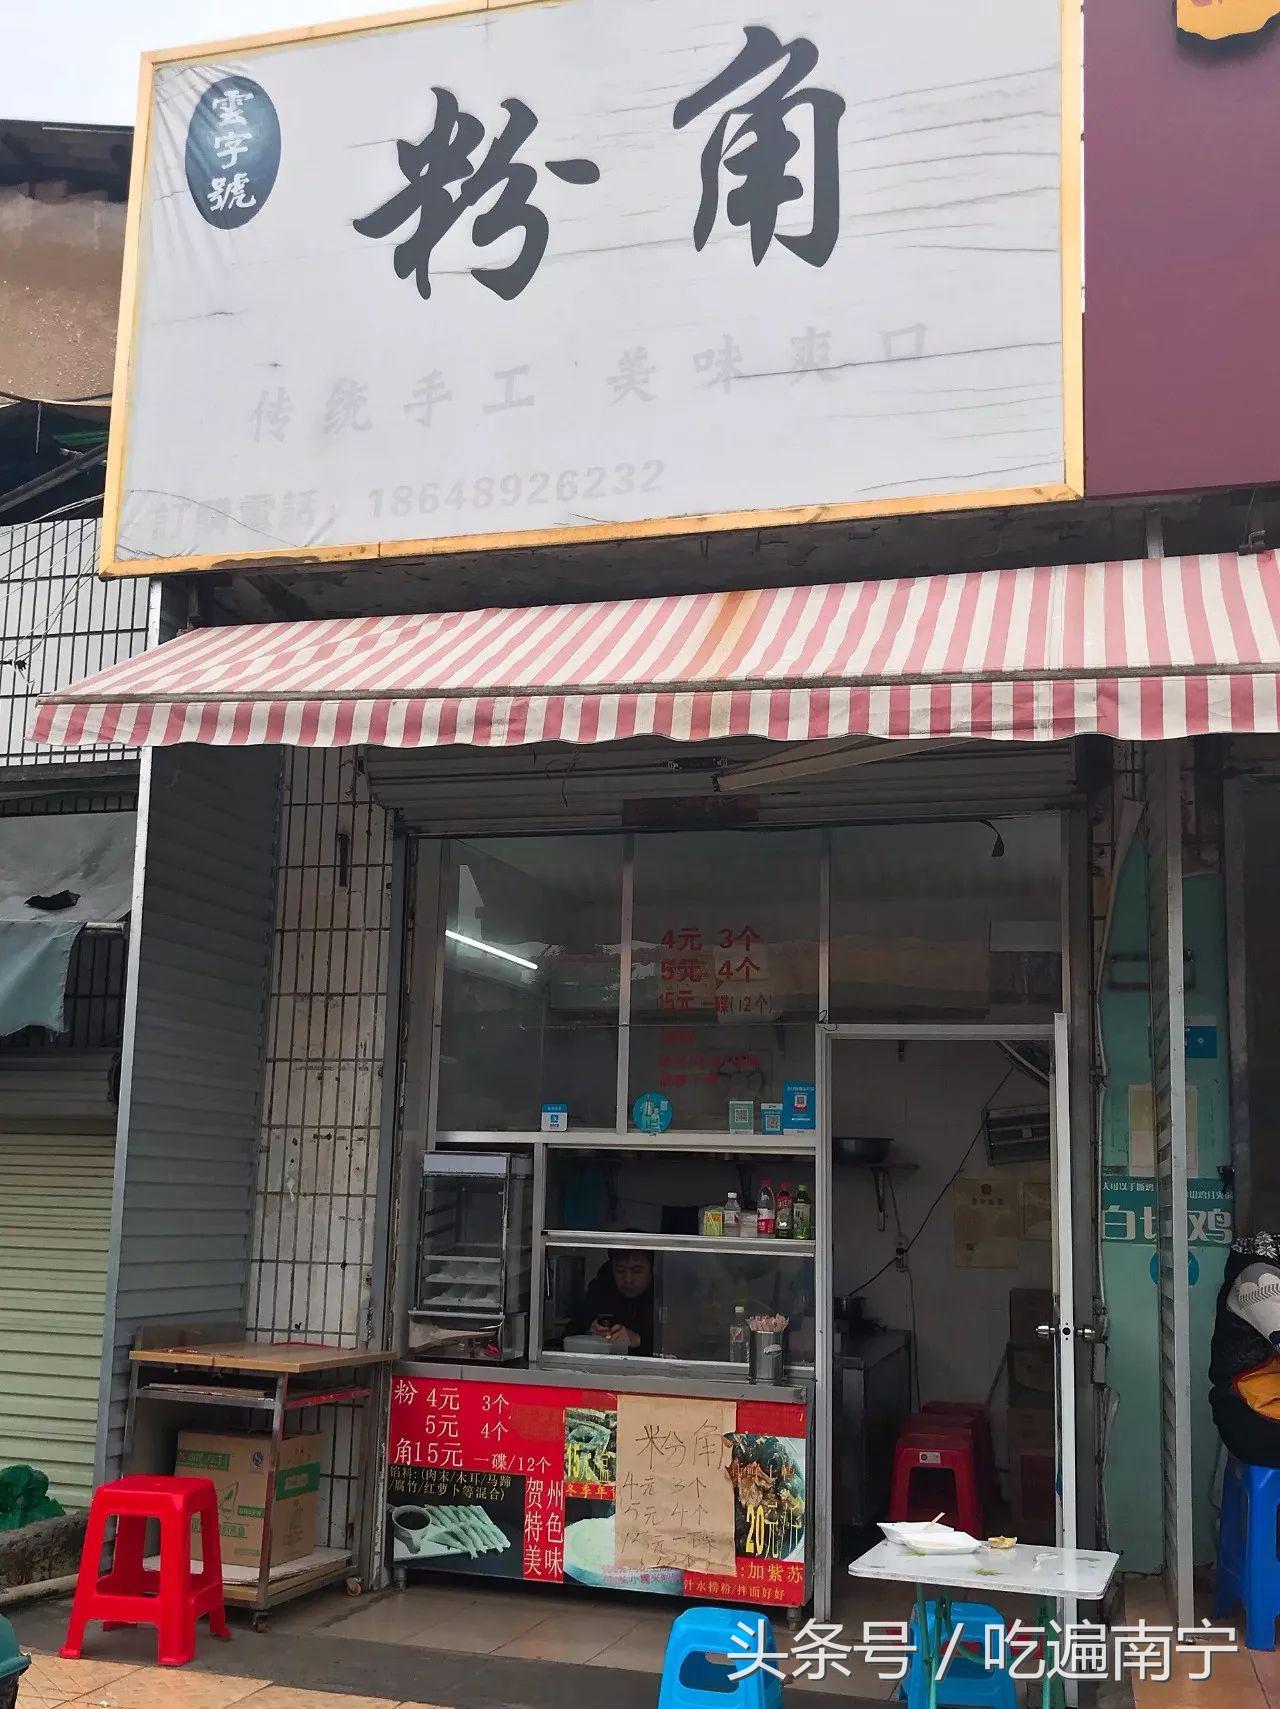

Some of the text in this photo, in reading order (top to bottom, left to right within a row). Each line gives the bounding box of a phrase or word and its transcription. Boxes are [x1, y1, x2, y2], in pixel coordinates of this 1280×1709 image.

[352, 25, 846, 300] 粉角
[368, 459, 667, 519] 18648926232
[661, 925, 760, 952] 4元 3个
[719, 956, 760, 984] 4个
[481, 1393, 510, 1415] 3个
[425, 1414, 509, 1442] 5元 4个
[622, 1471, 655, 1500] 4元
[670, 1502, 708, 1527] 4个
